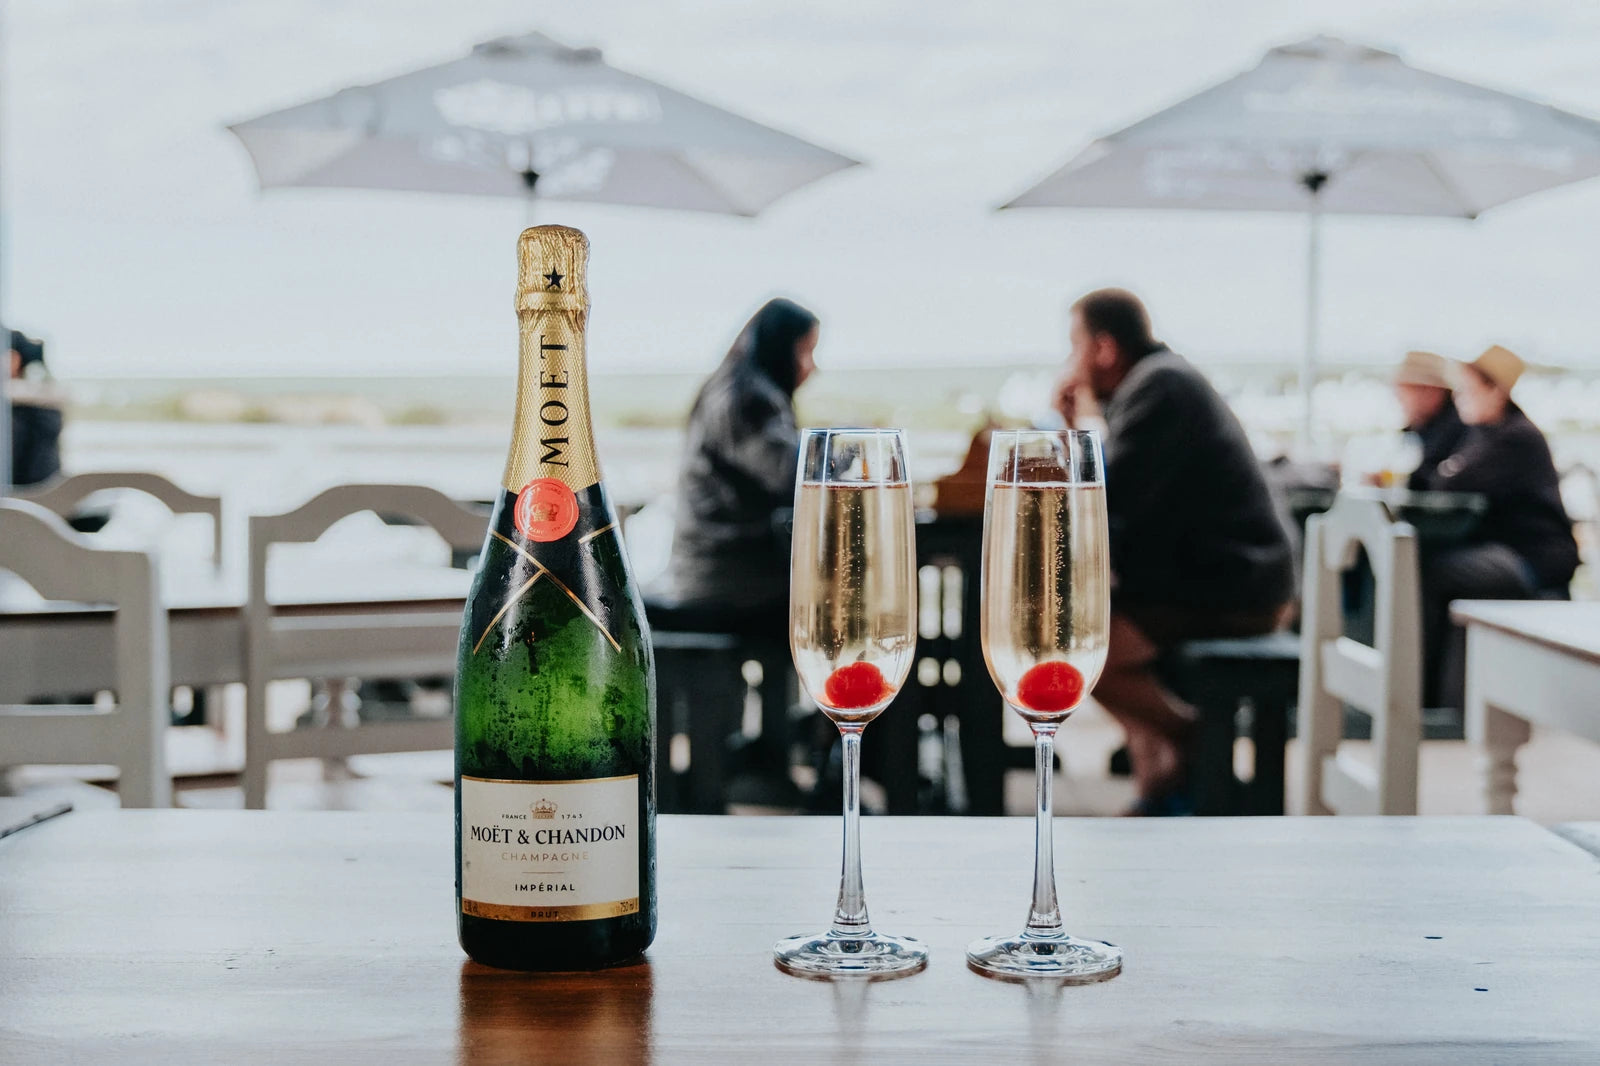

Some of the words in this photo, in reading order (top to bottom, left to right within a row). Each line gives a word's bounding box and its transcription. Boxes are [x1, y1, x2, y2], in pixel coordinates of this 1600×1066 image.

[471, 825, 513, 844] MOËT
[518, 833, 530, 844] &
[536, 824, 625, 844] CHANDON
[502, 852, 589, 861] CHAMPAGNE
[515, 882, 576, 891] IMPÉRIAL
